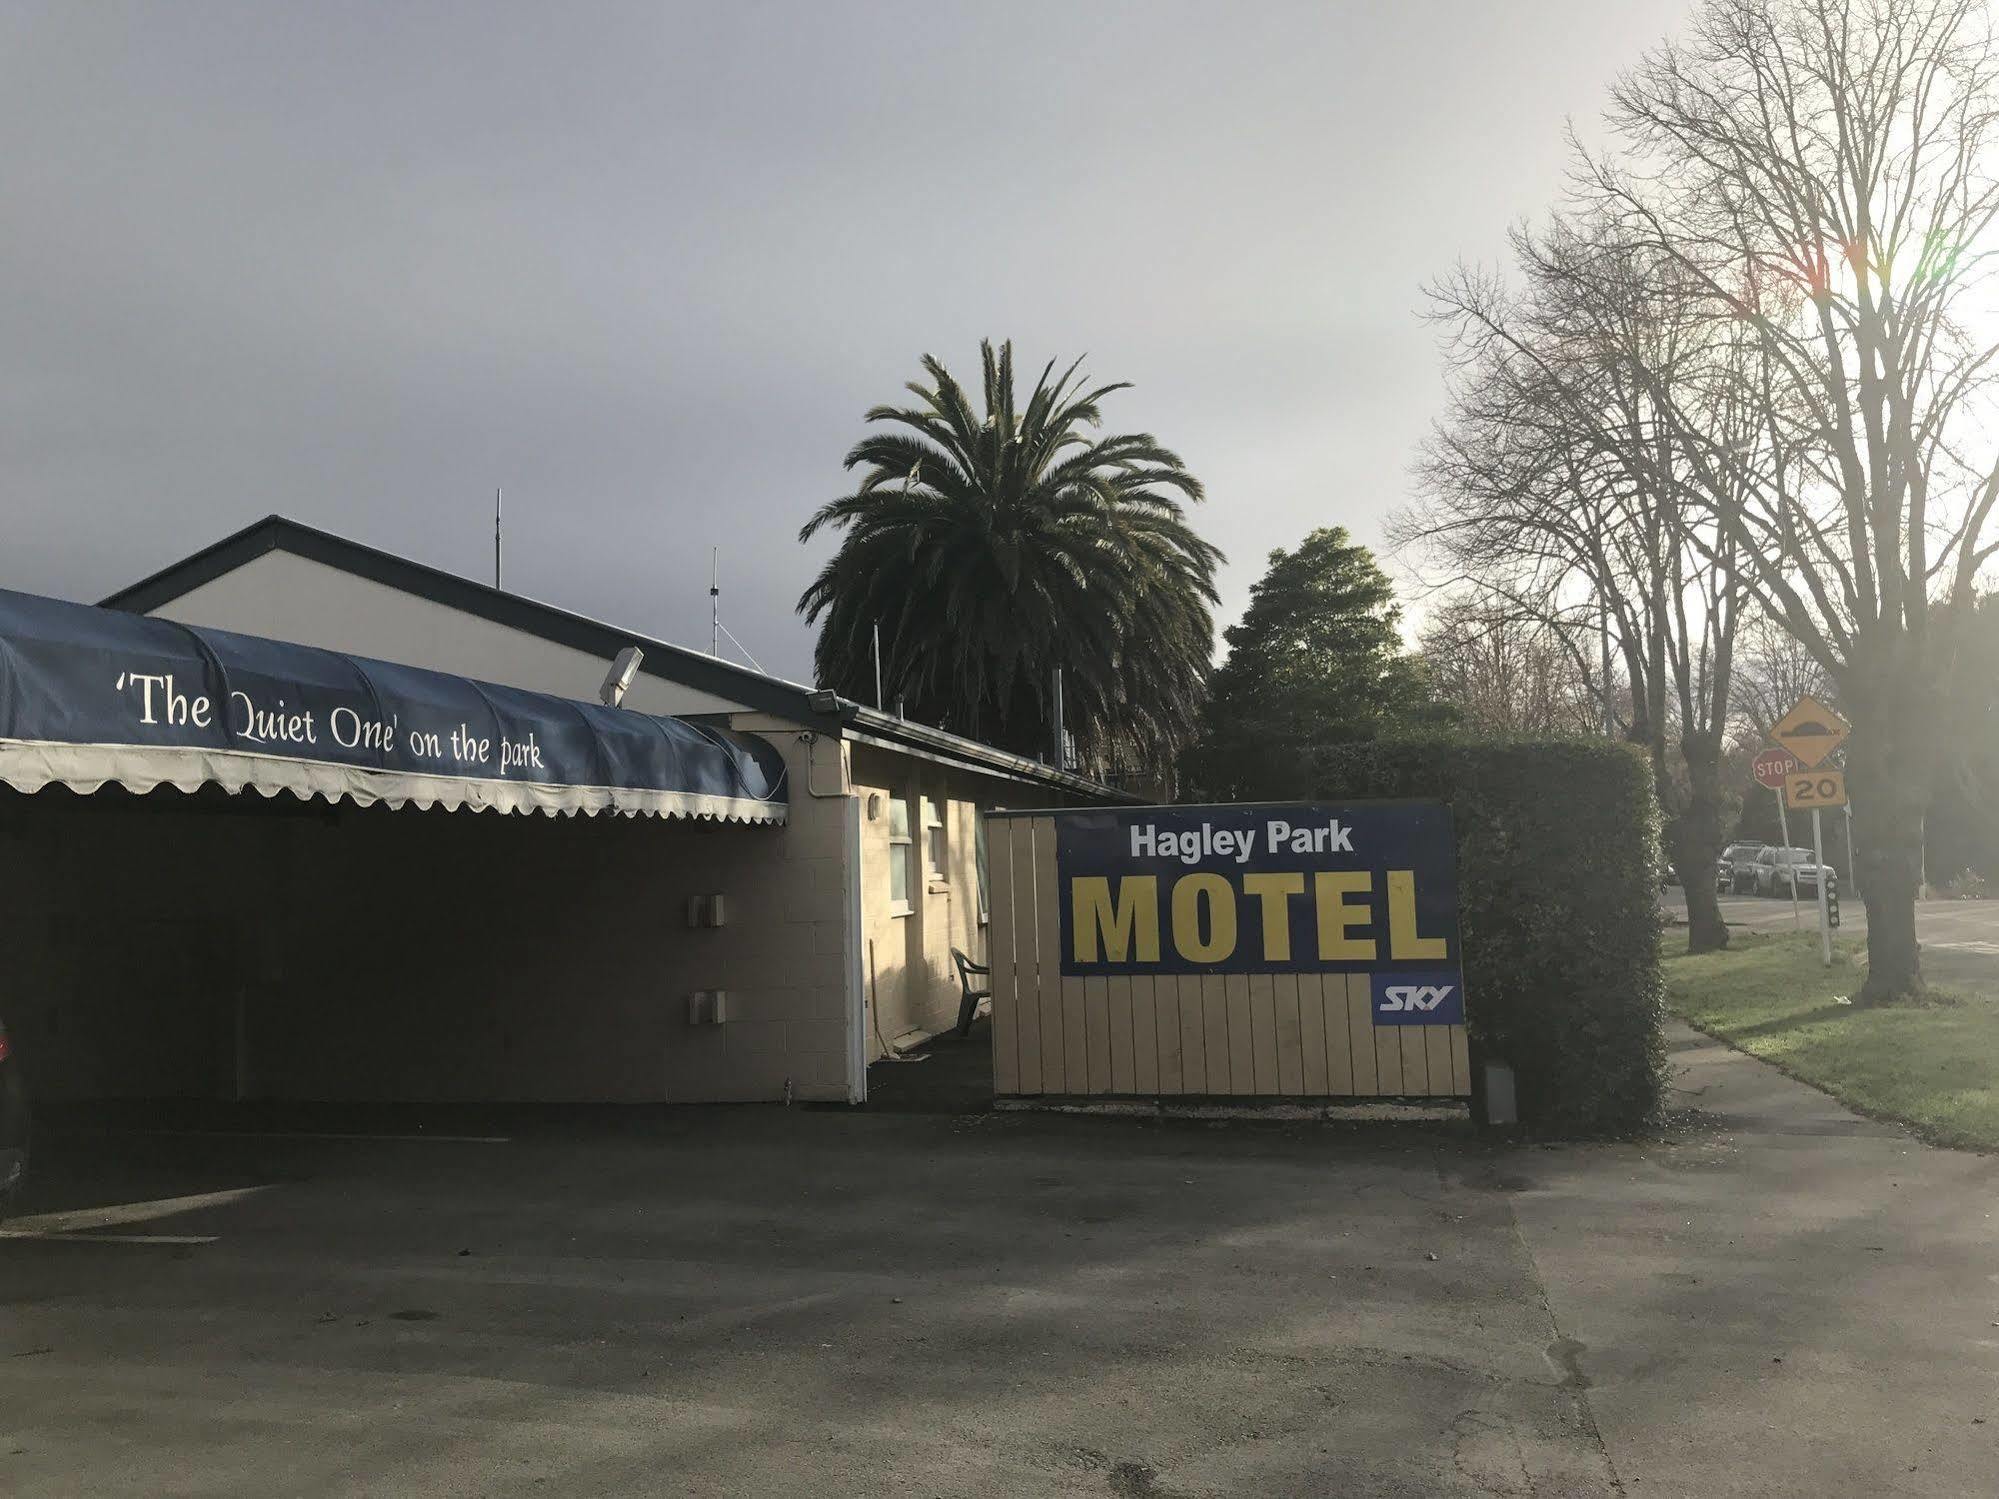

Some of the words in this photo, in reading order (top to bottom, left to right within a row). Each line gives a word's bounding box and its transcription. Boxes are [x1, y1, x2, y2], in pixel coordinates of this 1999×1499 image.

[231, 691, 317, 744] Quiet
[410, 731, 442, 758] on
[450, 723, 490, 763] the
[500, 733, 544, 775] park
[1757, 760, 1794, 777] STOP
[1794, 778, 1837, 800] 20
[1130, 822, 1256, 864] Hagley
[1266, 819, 1354, 854] Park
[1071, 870, 1447, 963] MOTEL
[1379, 985, 1455, 1011] SKY
